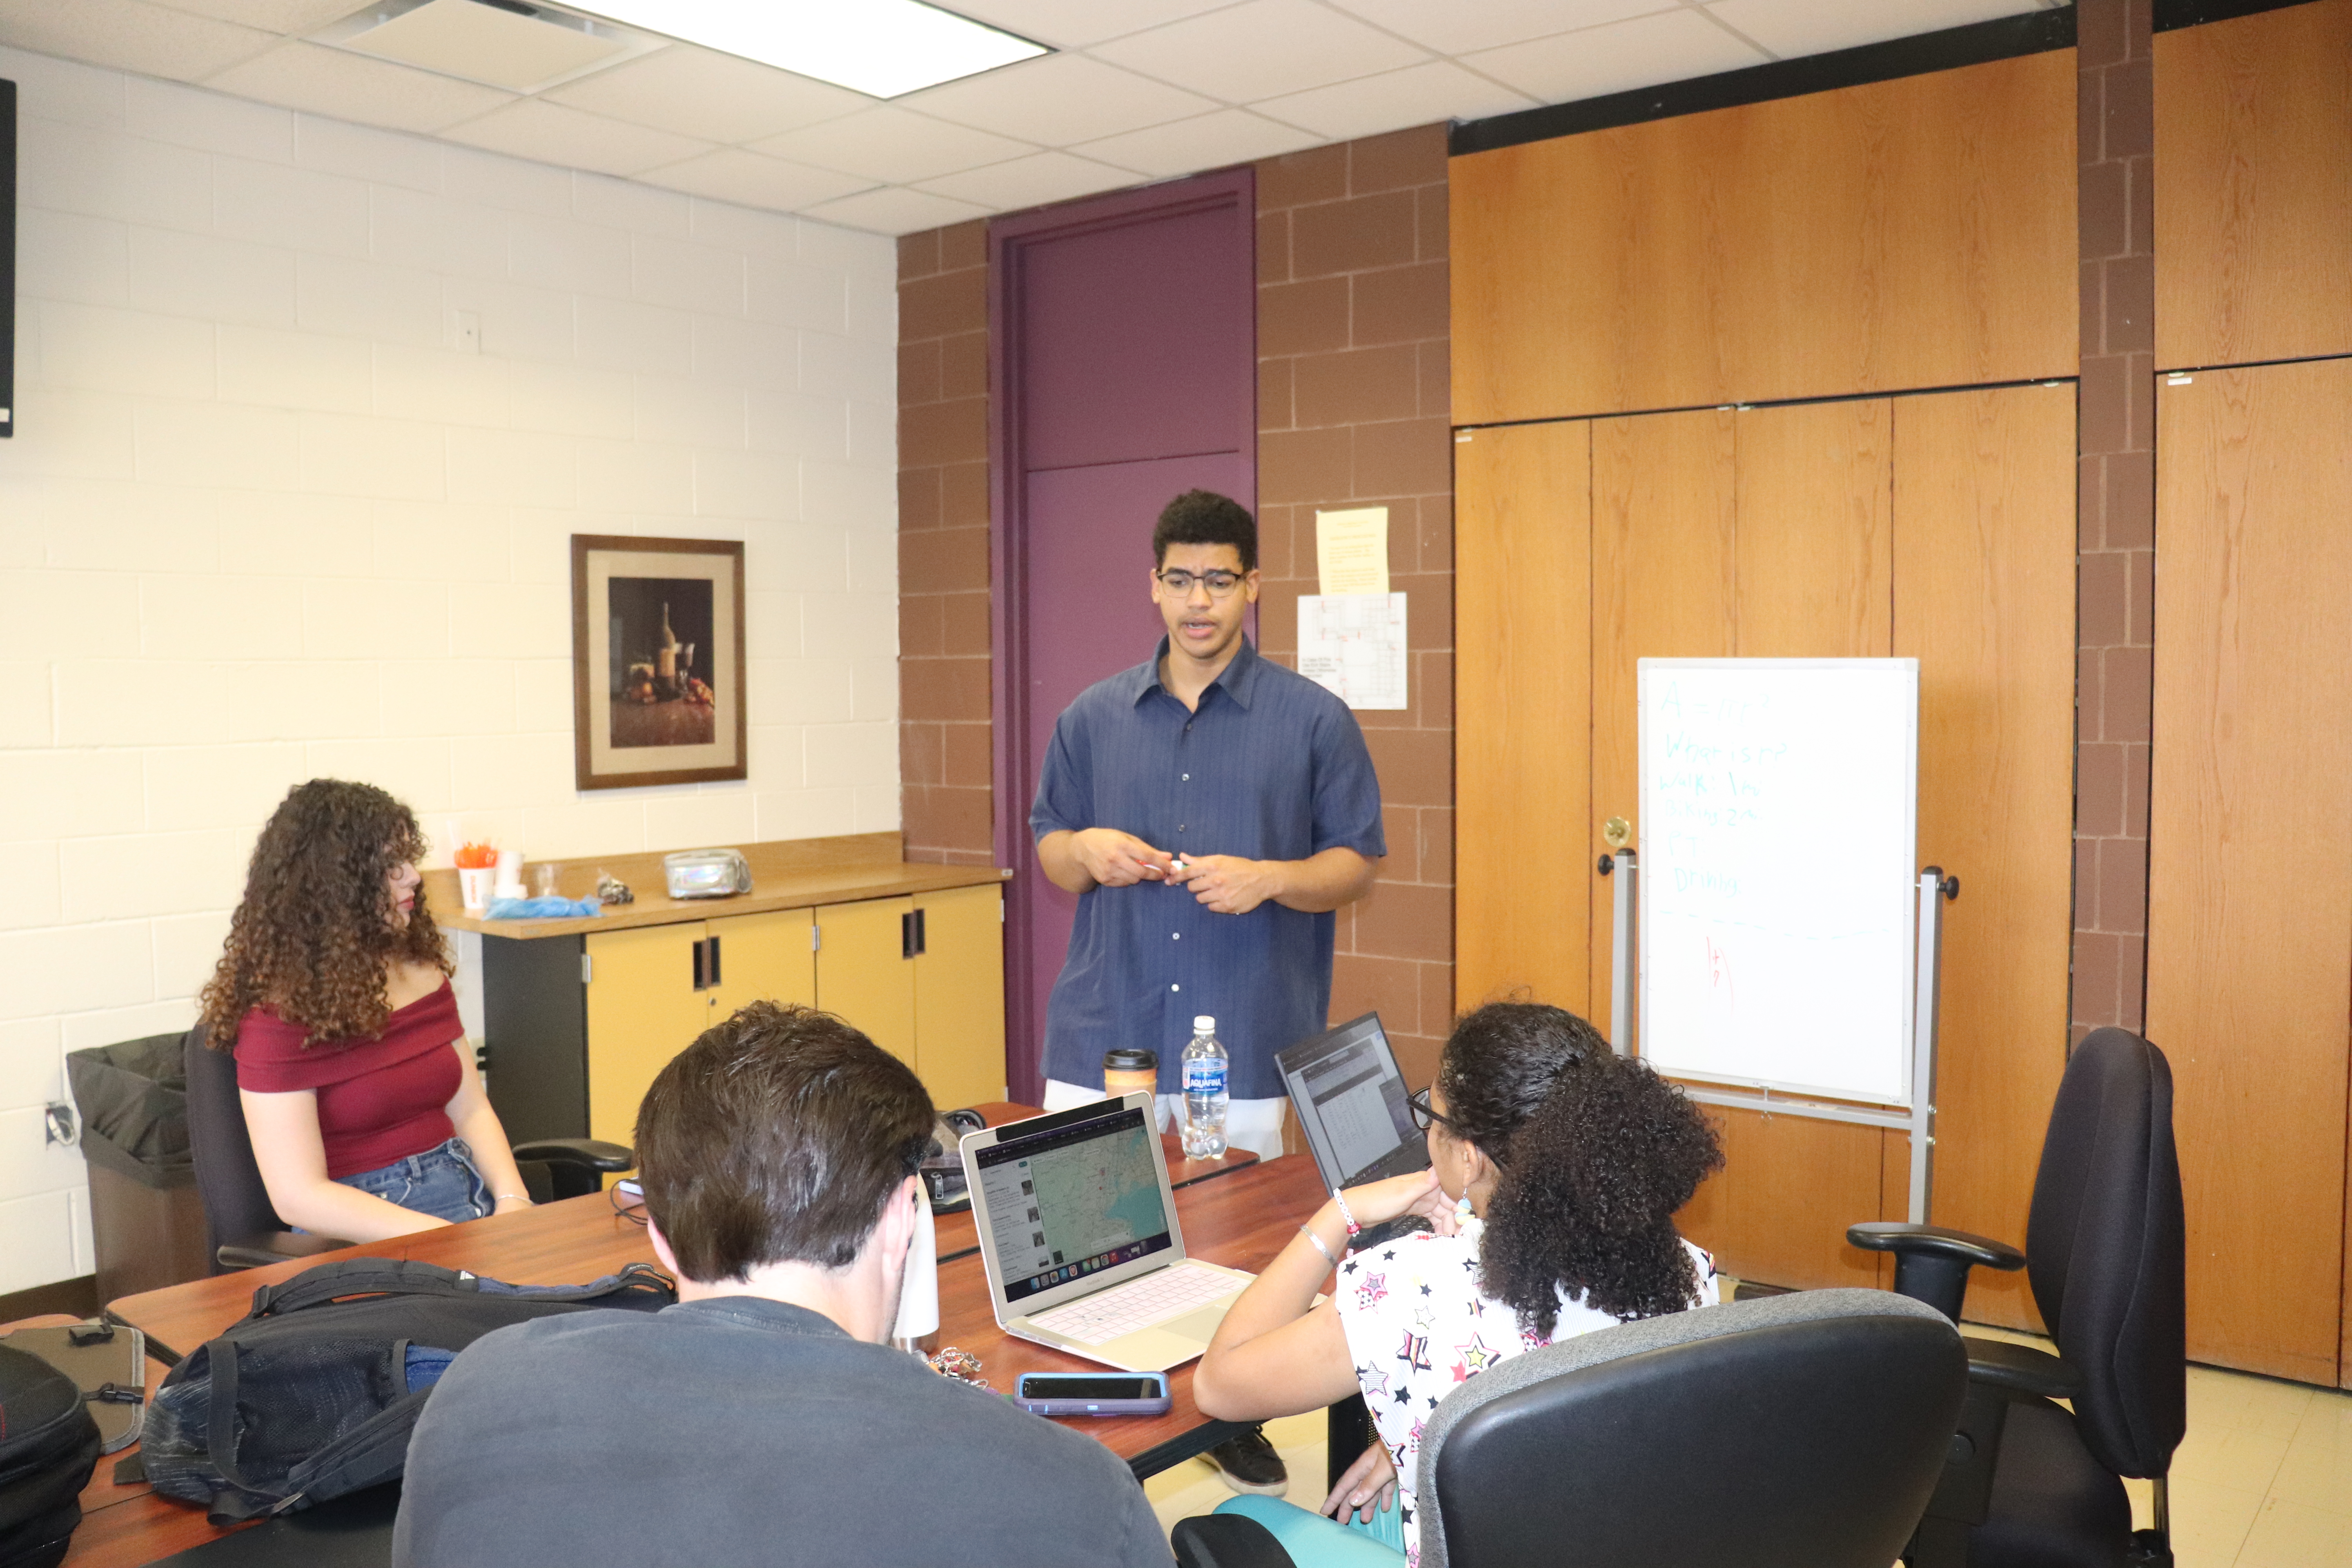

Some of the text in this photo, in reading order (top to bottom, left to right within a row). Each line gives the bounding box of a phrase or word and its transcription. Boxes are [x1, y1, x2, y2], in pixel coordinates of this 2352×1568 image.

[1661, 681, 1681, 719] A
[1666, 731, 1722, 766] What
[1730, 741, 1751, 764] is
[1190, 1078, 1221, 1088] AQUAFINA
